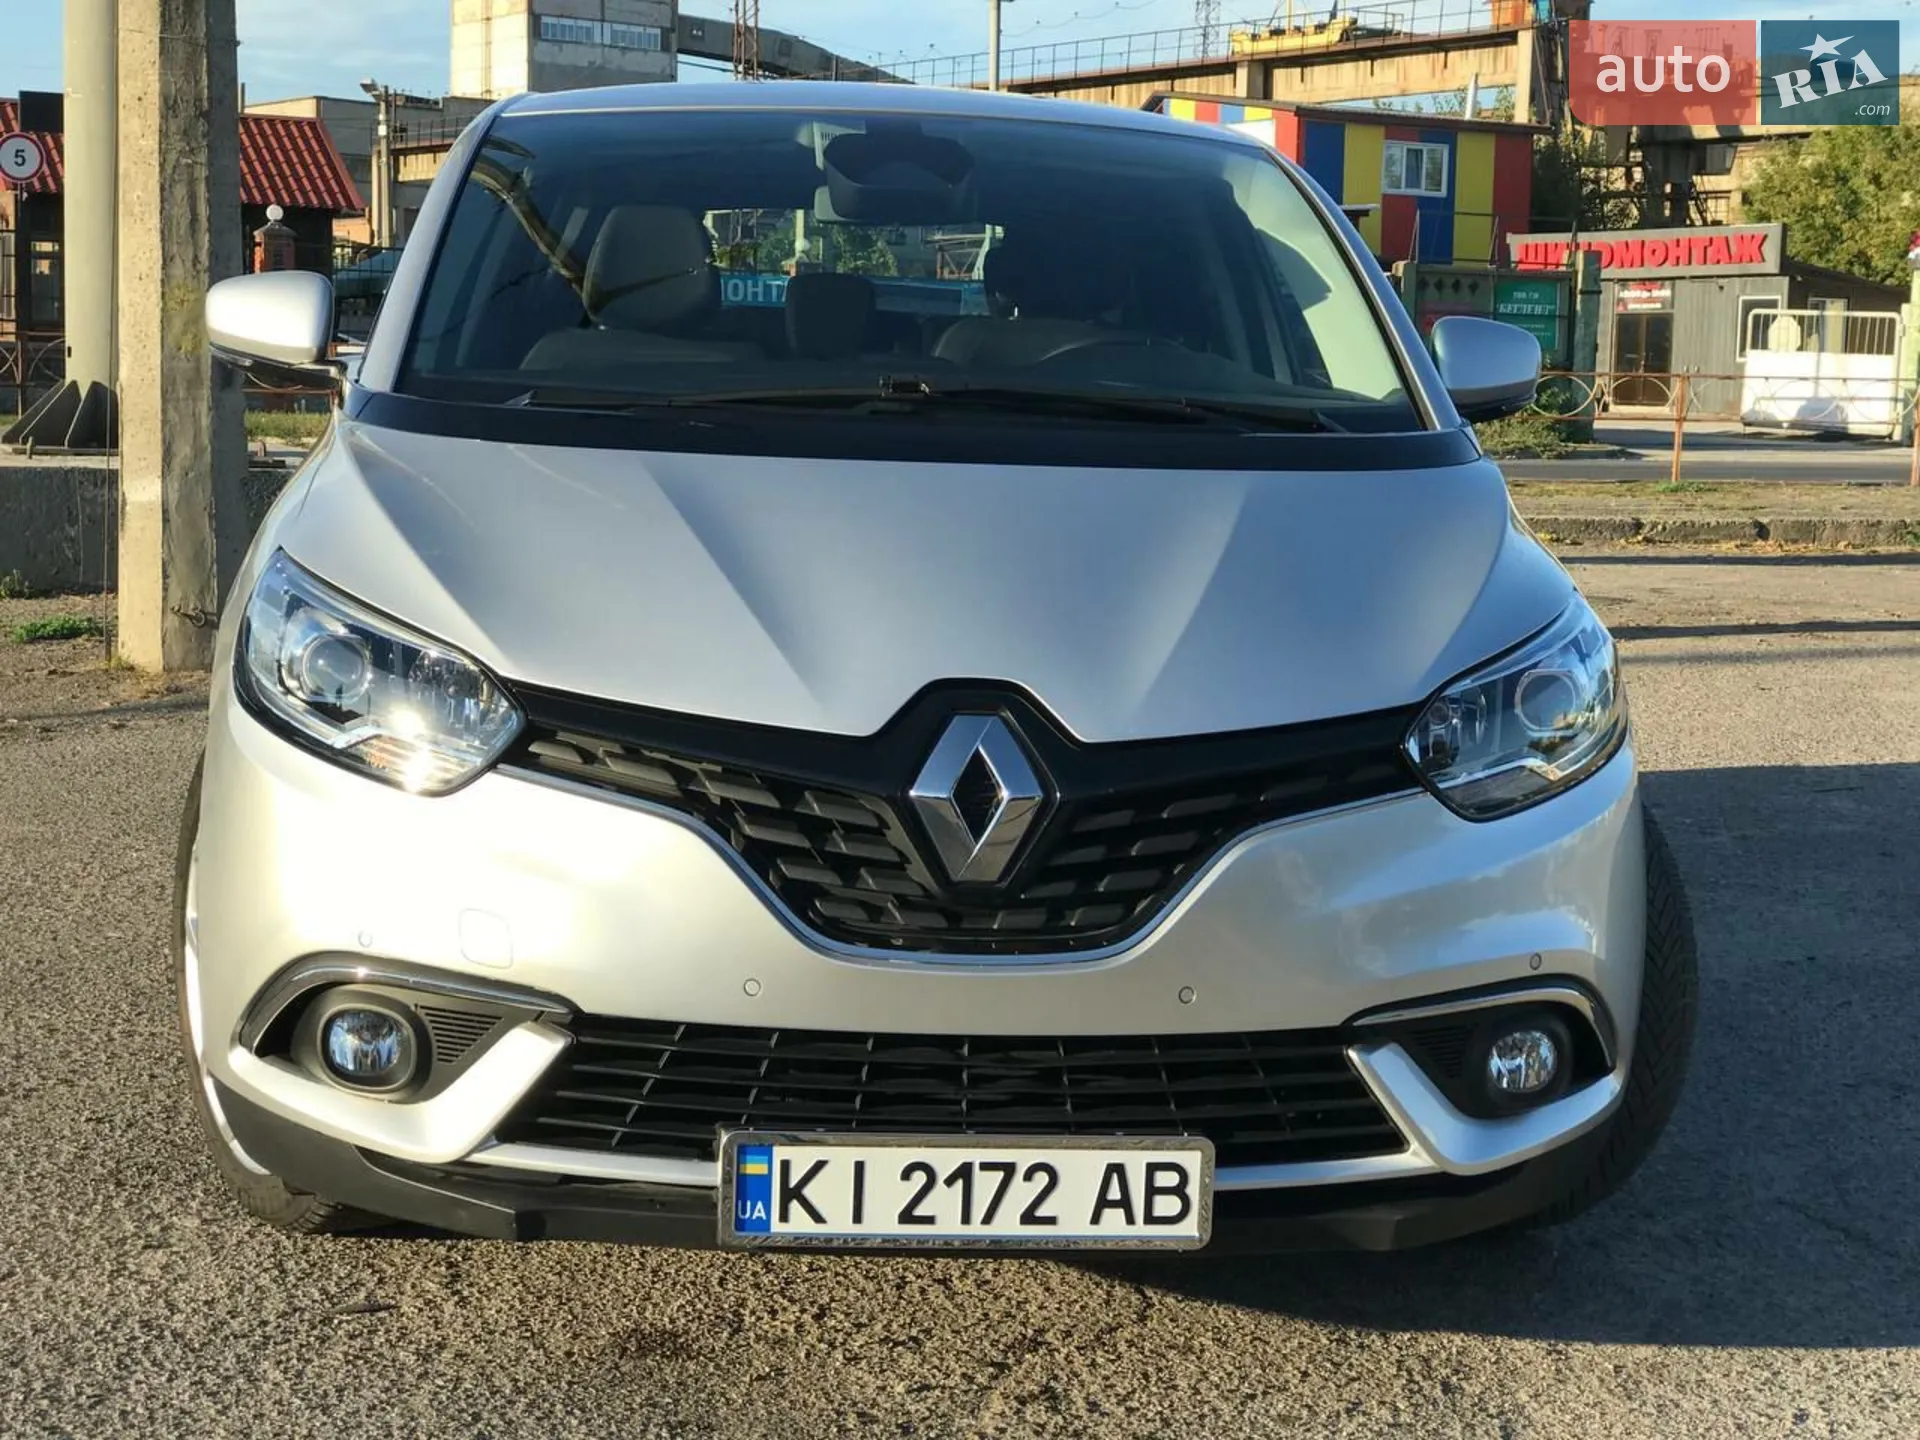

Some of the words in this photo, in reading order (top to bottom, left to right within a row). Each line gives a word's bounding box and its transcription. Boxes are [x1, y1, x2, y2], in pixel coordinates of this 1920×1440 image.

[14, 149, 26, 167] 5
[720, 277, 788, 302] ОНТ
[897, 1161, 1060, 1226] 2172
[1088, 1161, 1192, 1227] AB
[737, 1200, 767, 1221] UA
